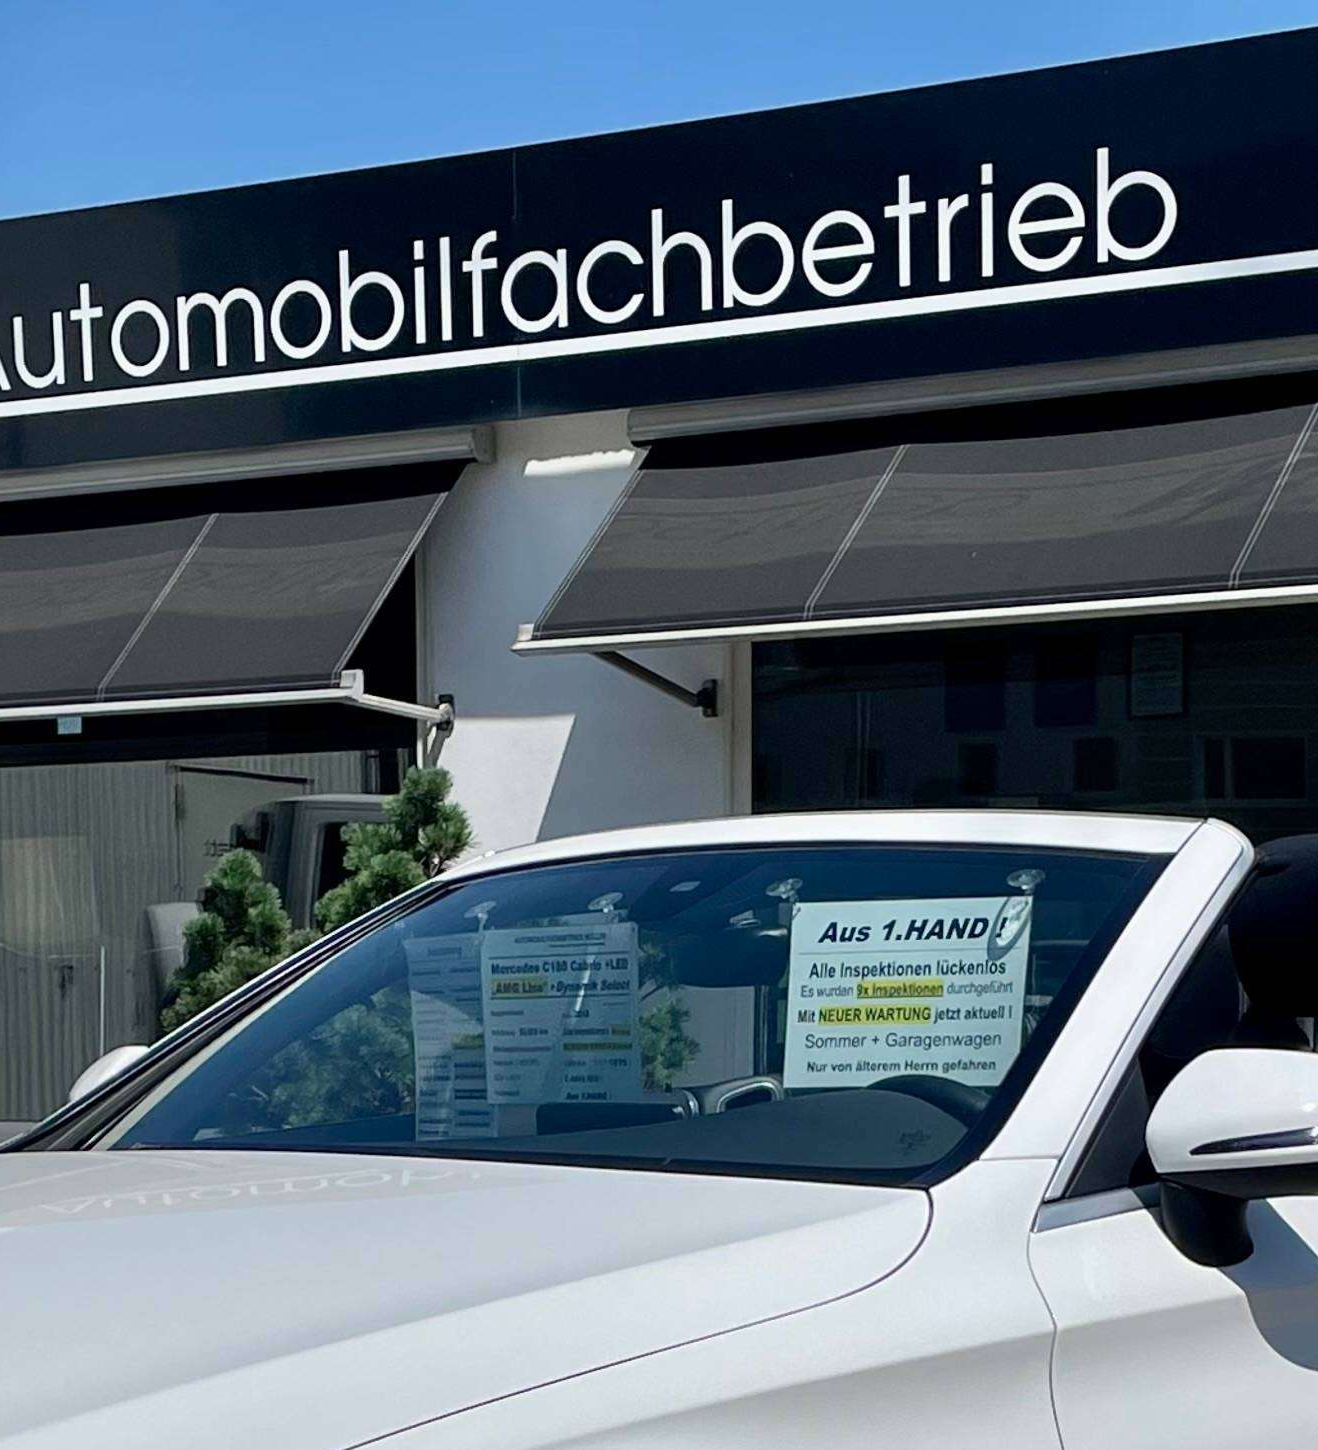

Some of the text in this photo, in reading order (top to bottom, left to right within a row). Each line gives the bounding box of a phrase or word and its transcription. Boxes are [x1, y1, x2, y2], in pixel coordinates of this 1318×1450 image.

[818, 916, 1009, 944] Aus 1.HAND !
[490, 962, 541, 976] Mercedes
[809, 958, 1007, 980] Alle Inspektionen lückenlos
[800, 980, 1014, 999] Es wurden 9x Inspektionen durchgeführt
[797, 1009, 815, 1023] Mit
[818, 1008, 862, 1023] NEUER
[864, 1006, 931, 1022] WARTUNG
[934, 1005, 961, 1024] jetzt
[964, 1005, 1005, 1020] aktuell
[804, 1035, 867, 1050] Sommer
[884, 1032, 1002, 1051] Garagenwagen
[806, 1058, 997, 1074] Nur von älterem Herrn gefahren
